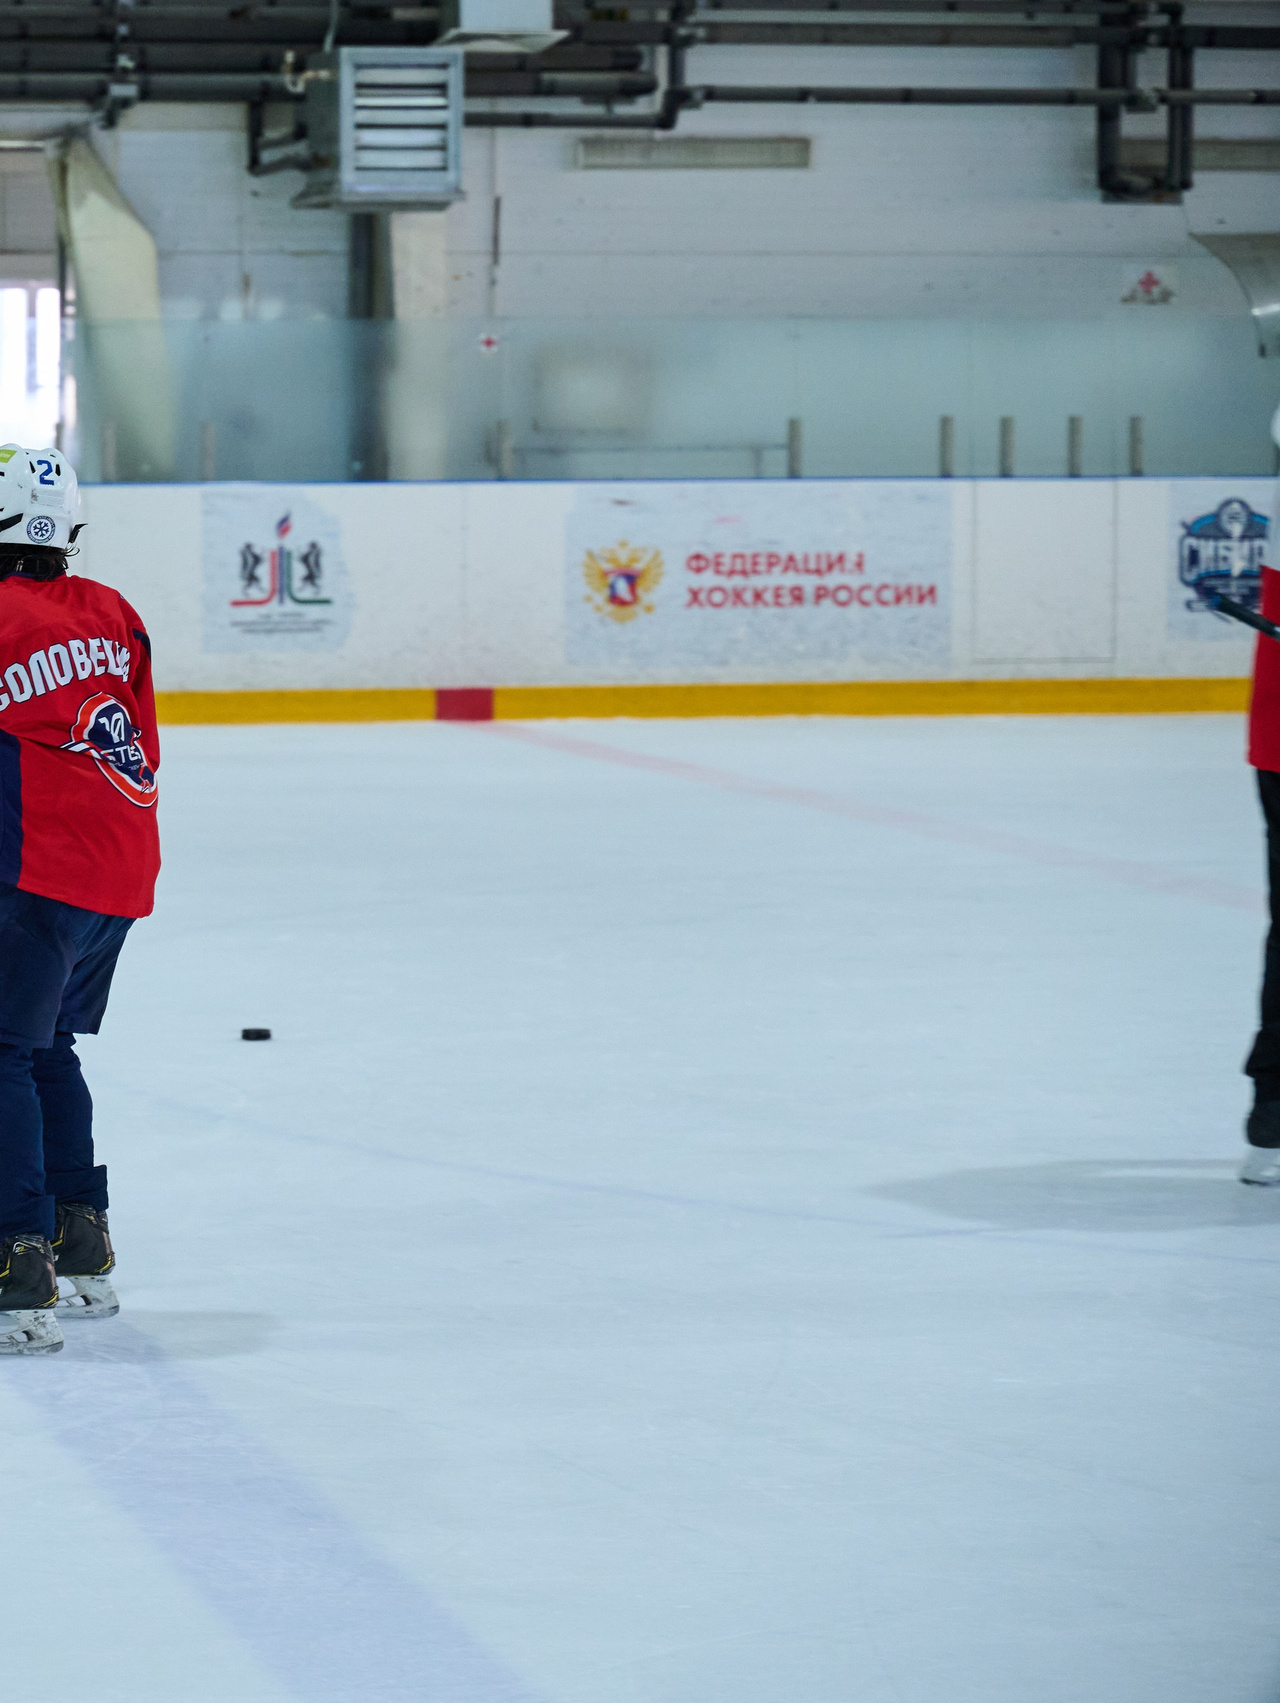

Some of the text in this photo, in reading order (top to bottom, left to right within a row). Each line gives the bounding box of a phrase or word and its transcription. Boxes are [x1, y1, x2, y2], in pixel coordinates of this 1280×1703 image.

[37, 459, 54, 485] 2
[686, 584, 936, 607] ХОККЕЯ РОССИИ
